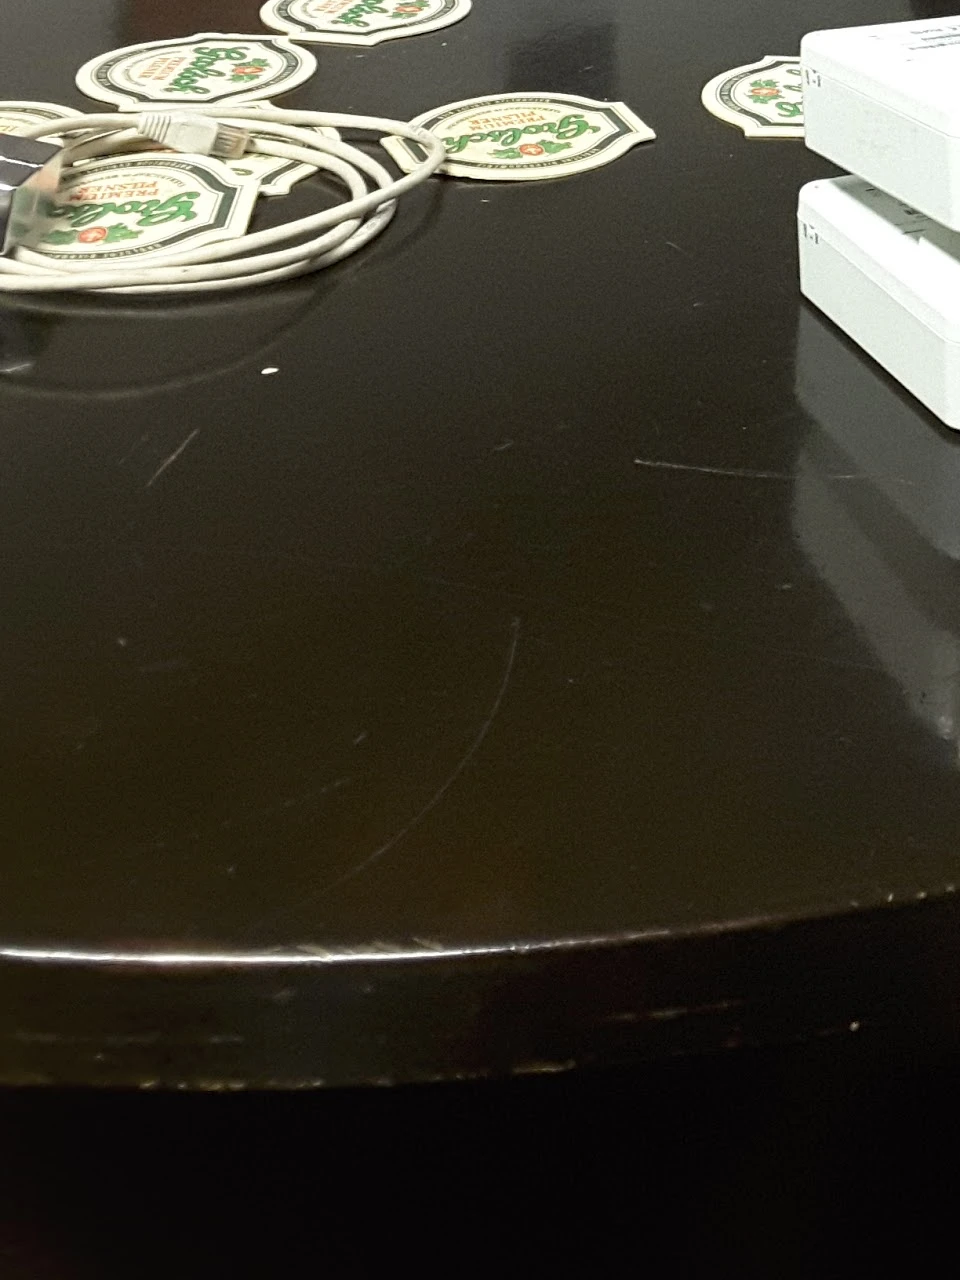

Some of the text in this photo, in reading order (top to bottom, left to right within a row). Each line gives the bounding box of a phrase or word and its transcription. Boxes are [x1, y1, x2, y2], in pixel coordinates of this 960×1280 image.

[163, 46, 250, 95] Grolsch
[468, 116, 547, 131] PREMIUM
[471, 110, 537, 126] PILSNER
[442, 114, 600, 153] Grolsch
